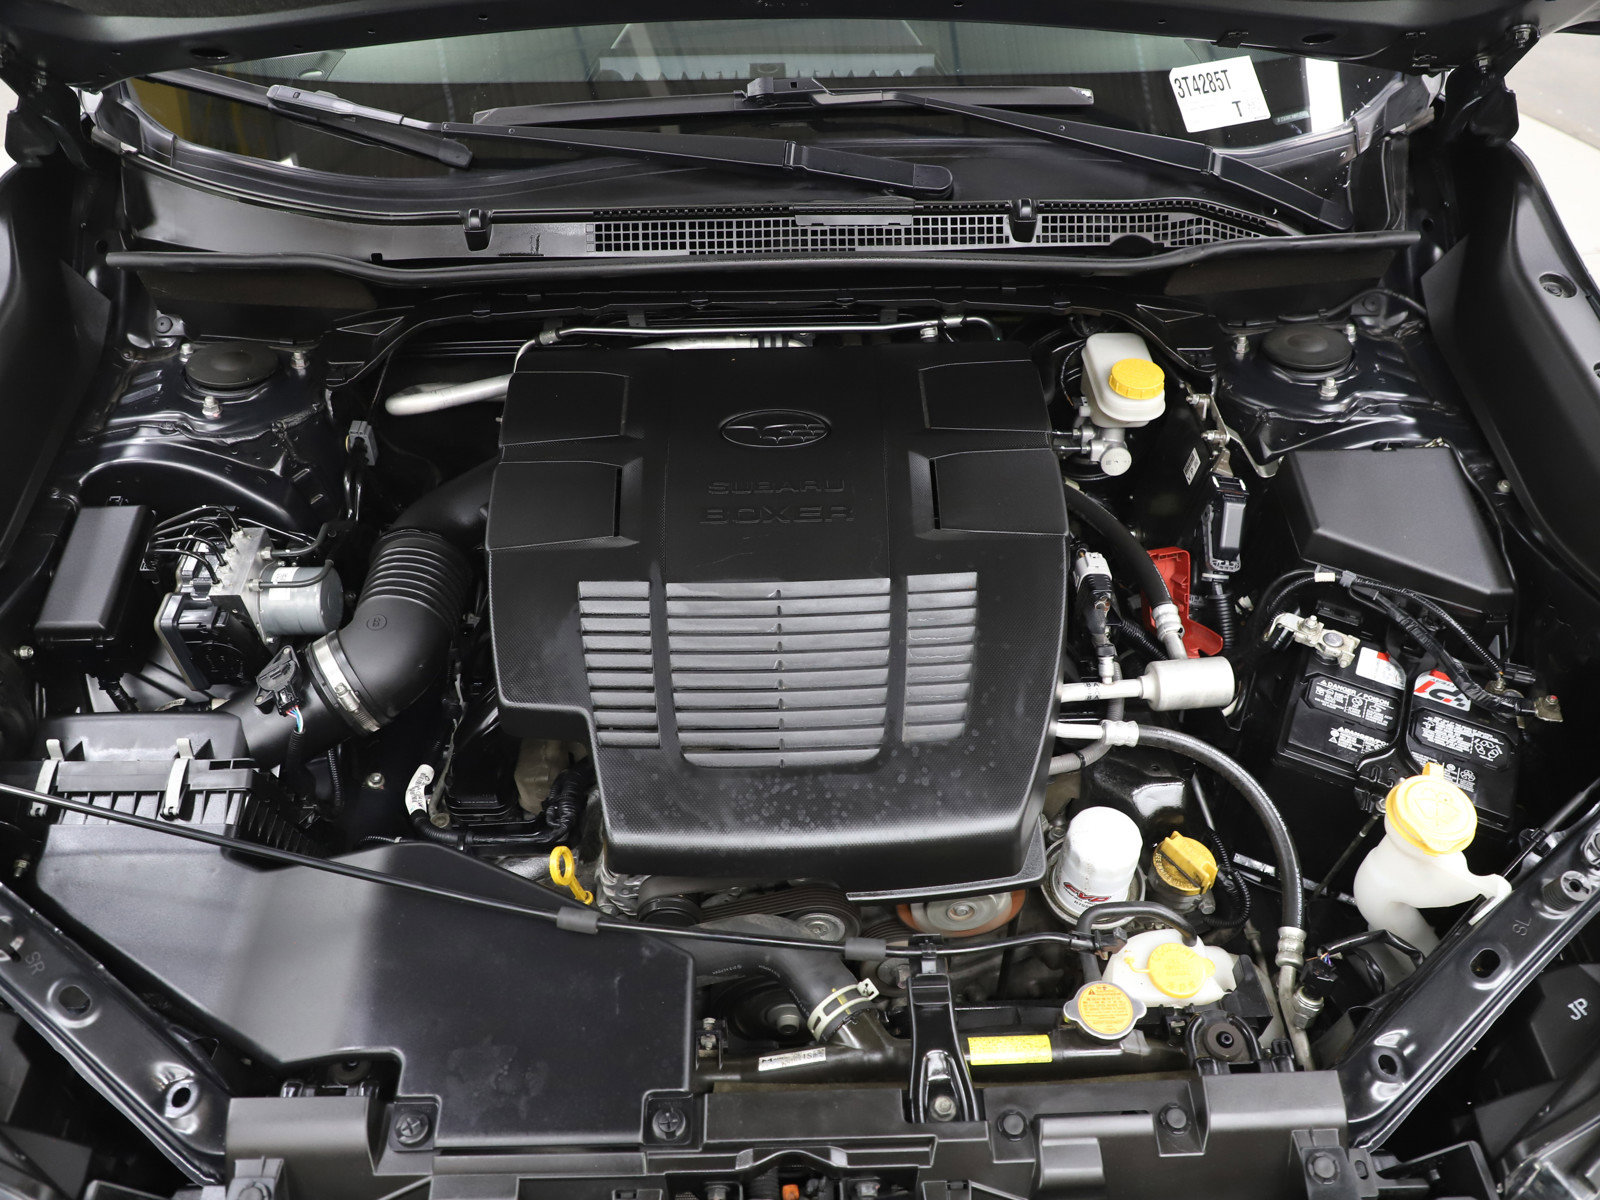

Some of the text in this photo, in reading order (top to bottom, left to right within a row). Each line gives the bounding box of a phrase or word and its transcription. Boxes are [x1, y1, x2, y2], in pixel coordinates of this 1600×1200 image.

[1174, 69, 1231, 98] 3T4285T
[1232, 100, 1242, 117] T
[708, 480, 845, 495] SUBARU
[699, 505, 855, 525] BOXER
[1327, 682, 1357, 695] DANGER
[1363, 694, 1390, 706] POISON
[1512, 917, 1532, 936] SL
[25, 951, 45, 975] SR
[1567, 998, 1588, 1020] JP
